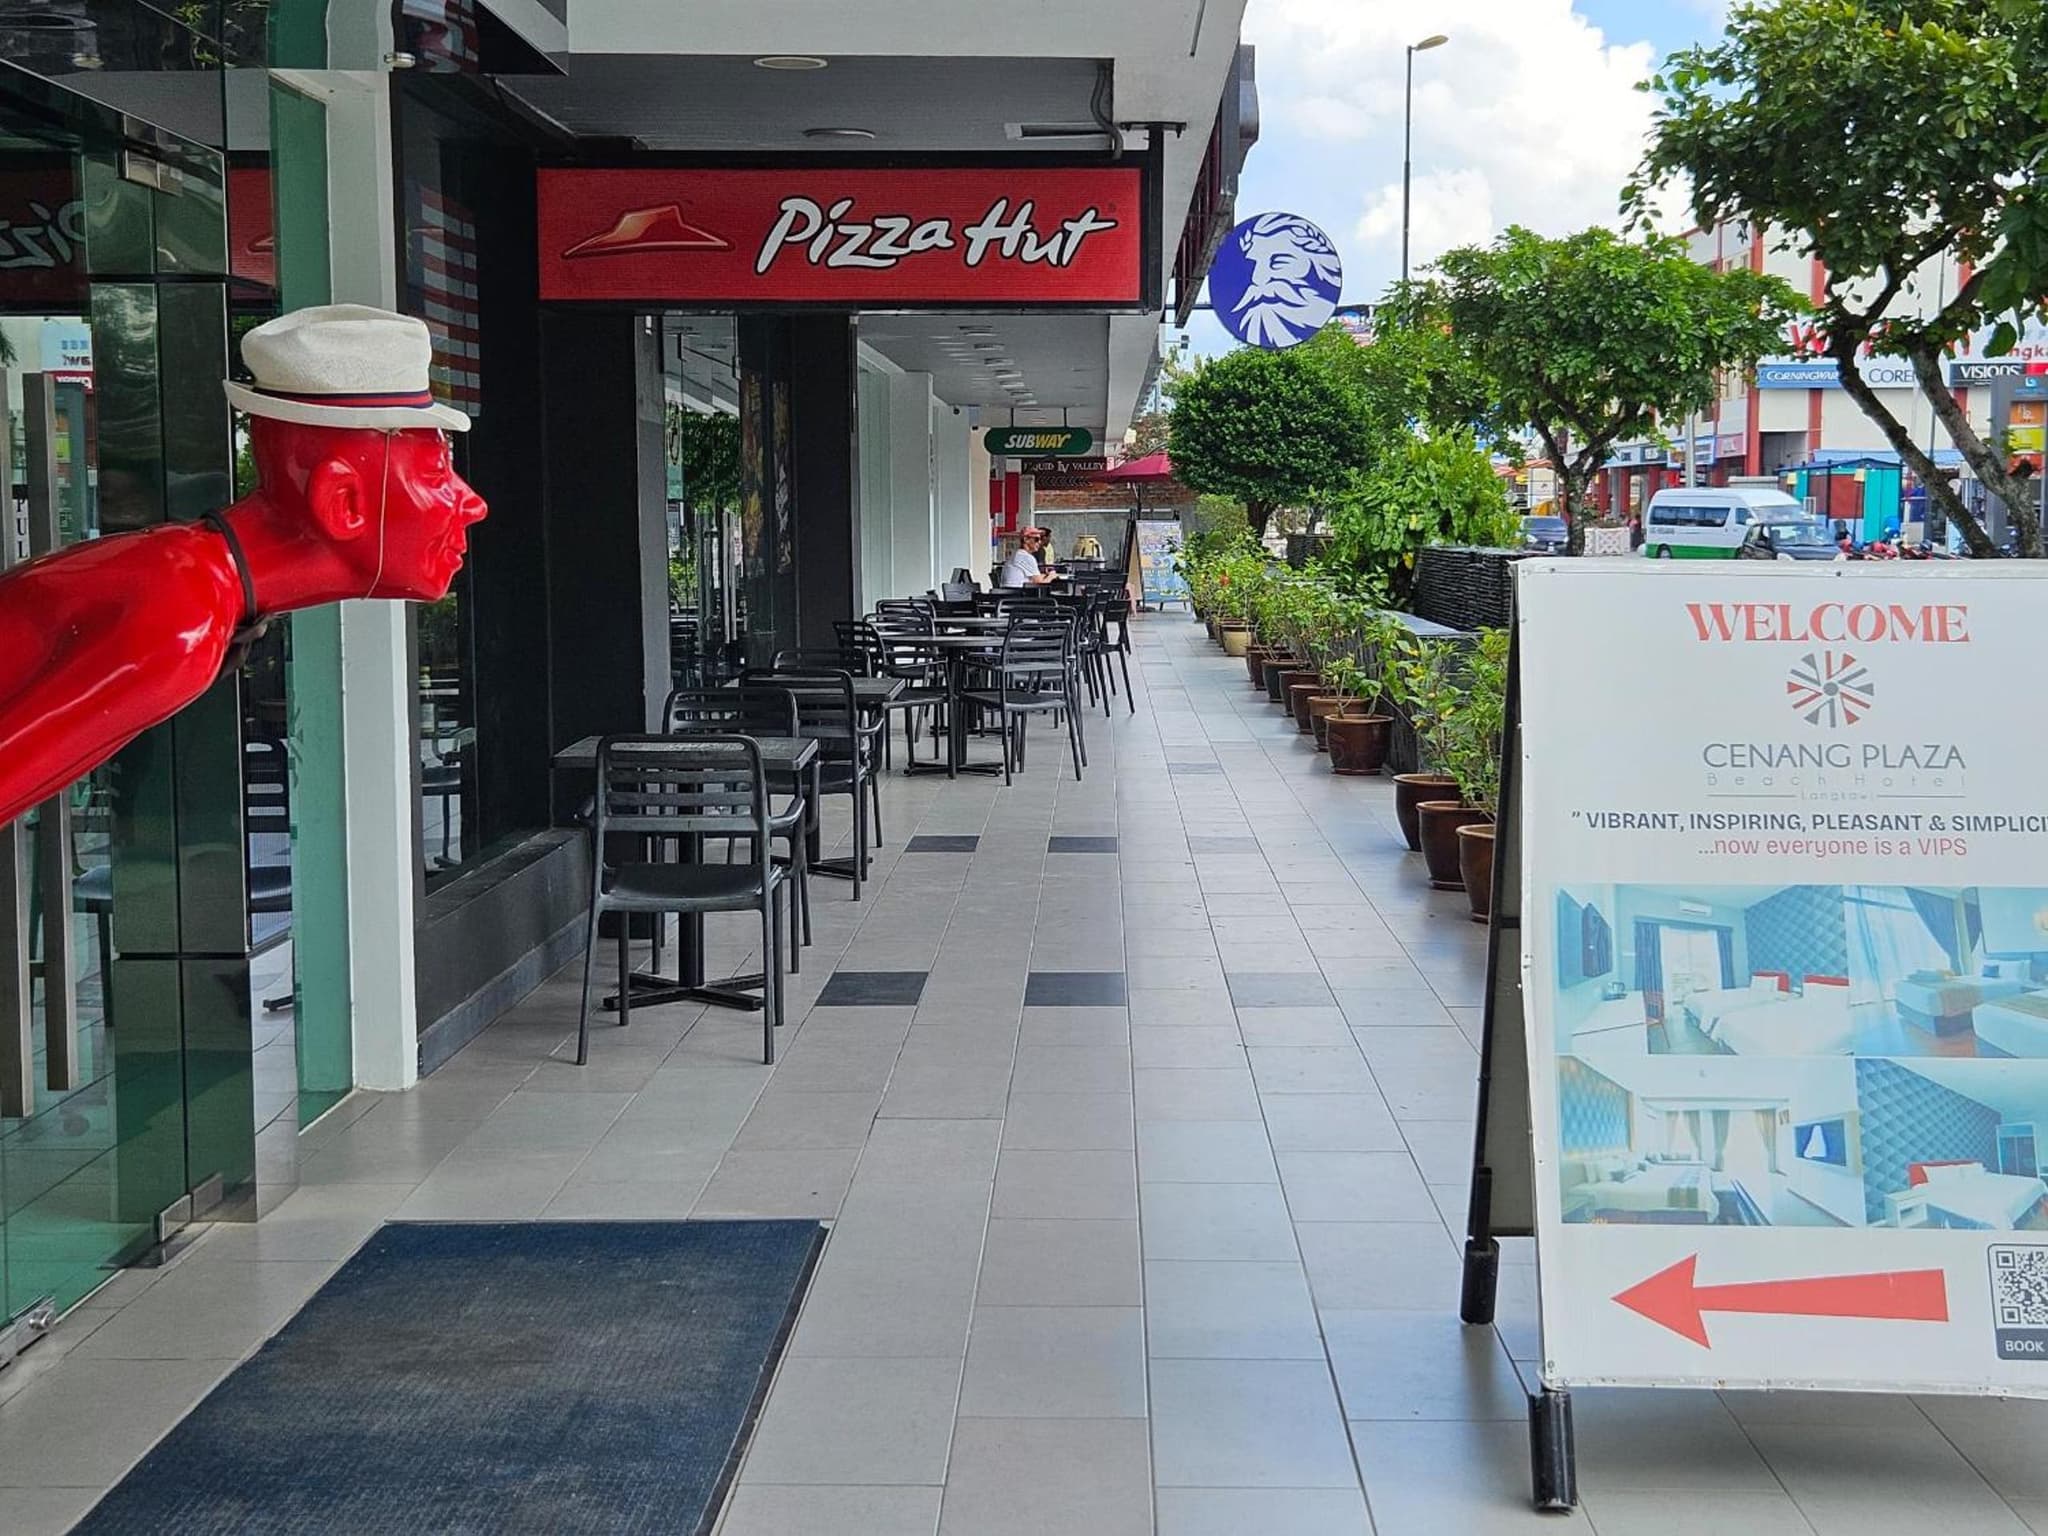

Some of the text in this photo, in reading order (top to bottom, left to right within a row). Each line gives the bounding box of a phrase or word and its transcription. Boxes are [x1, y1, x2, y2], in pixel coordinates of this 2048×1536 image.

[755, 197, 1118, 275] Pizza Hut
[1767, 370, 1840, 382] CORNINGWAR
[1868, 368, 1916, 384] CORE
[1004, 433, 1072, 449] SUBWAY
[1685, 603, 1971, 643] WELCOME
[1703, 743, 1967, 769] CENANG PLAZA
[1706, 773, 1966, 787] Beach Hotel
[1586, 812, 1685, 832] VIBRANT,
[1690, 813, 1806, 832] INSPIRING,
[1812, 814, 1922, 831] PLEASANT
[1929, 814, 1946, 831] &
[1951, 815, 2048, 832] SIMPLICI
[1698, 836, 1968, 858] ...now everyone is a VIPS
[2005, 1339, 2045, 1353] BOOK
